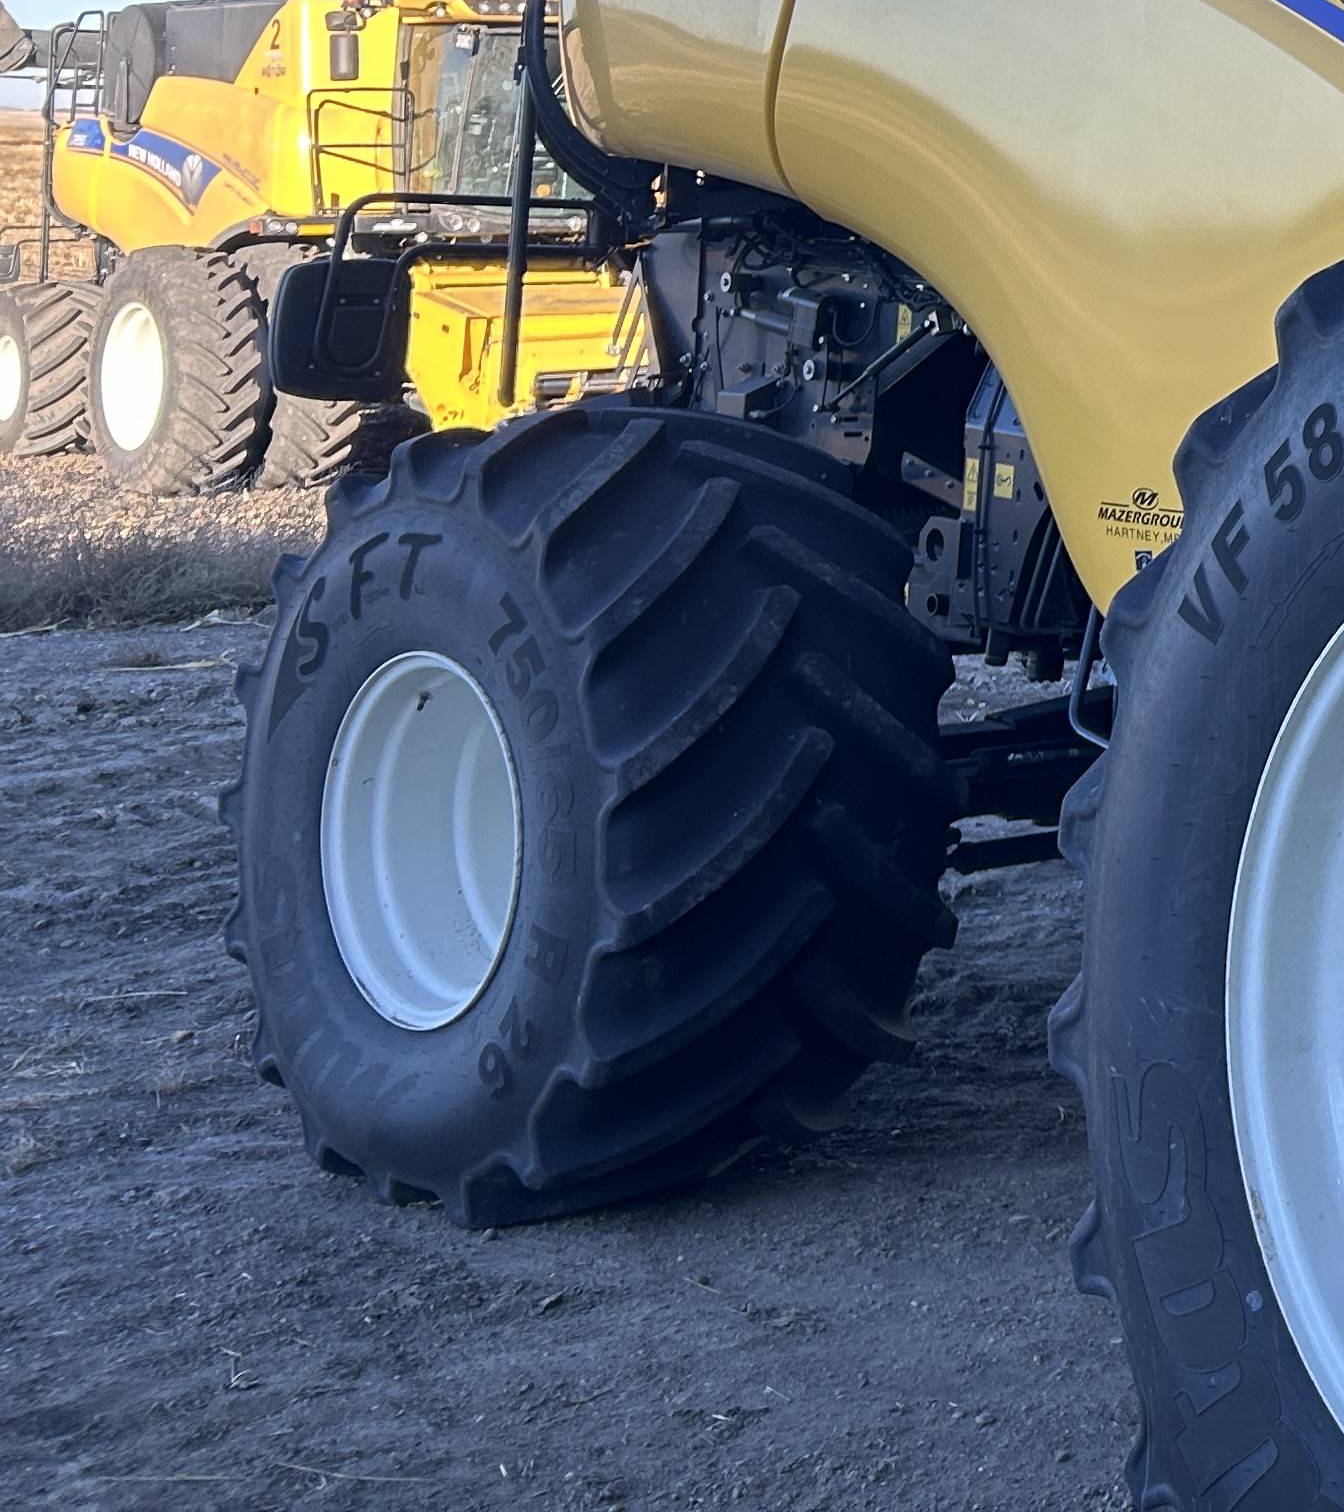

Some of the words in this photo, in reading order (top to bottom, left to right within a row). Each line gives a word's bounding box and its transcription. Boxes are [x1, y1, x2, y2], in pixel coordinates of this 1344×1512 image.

[270, 19, 281, 50] 2
[128, 144, 148, 163] NEW
[148, 151, 181, 187] HOLLAND
[1098, 507, 1184, 529] MAZERGROU
[1177, 499, 1250, 645] VF
